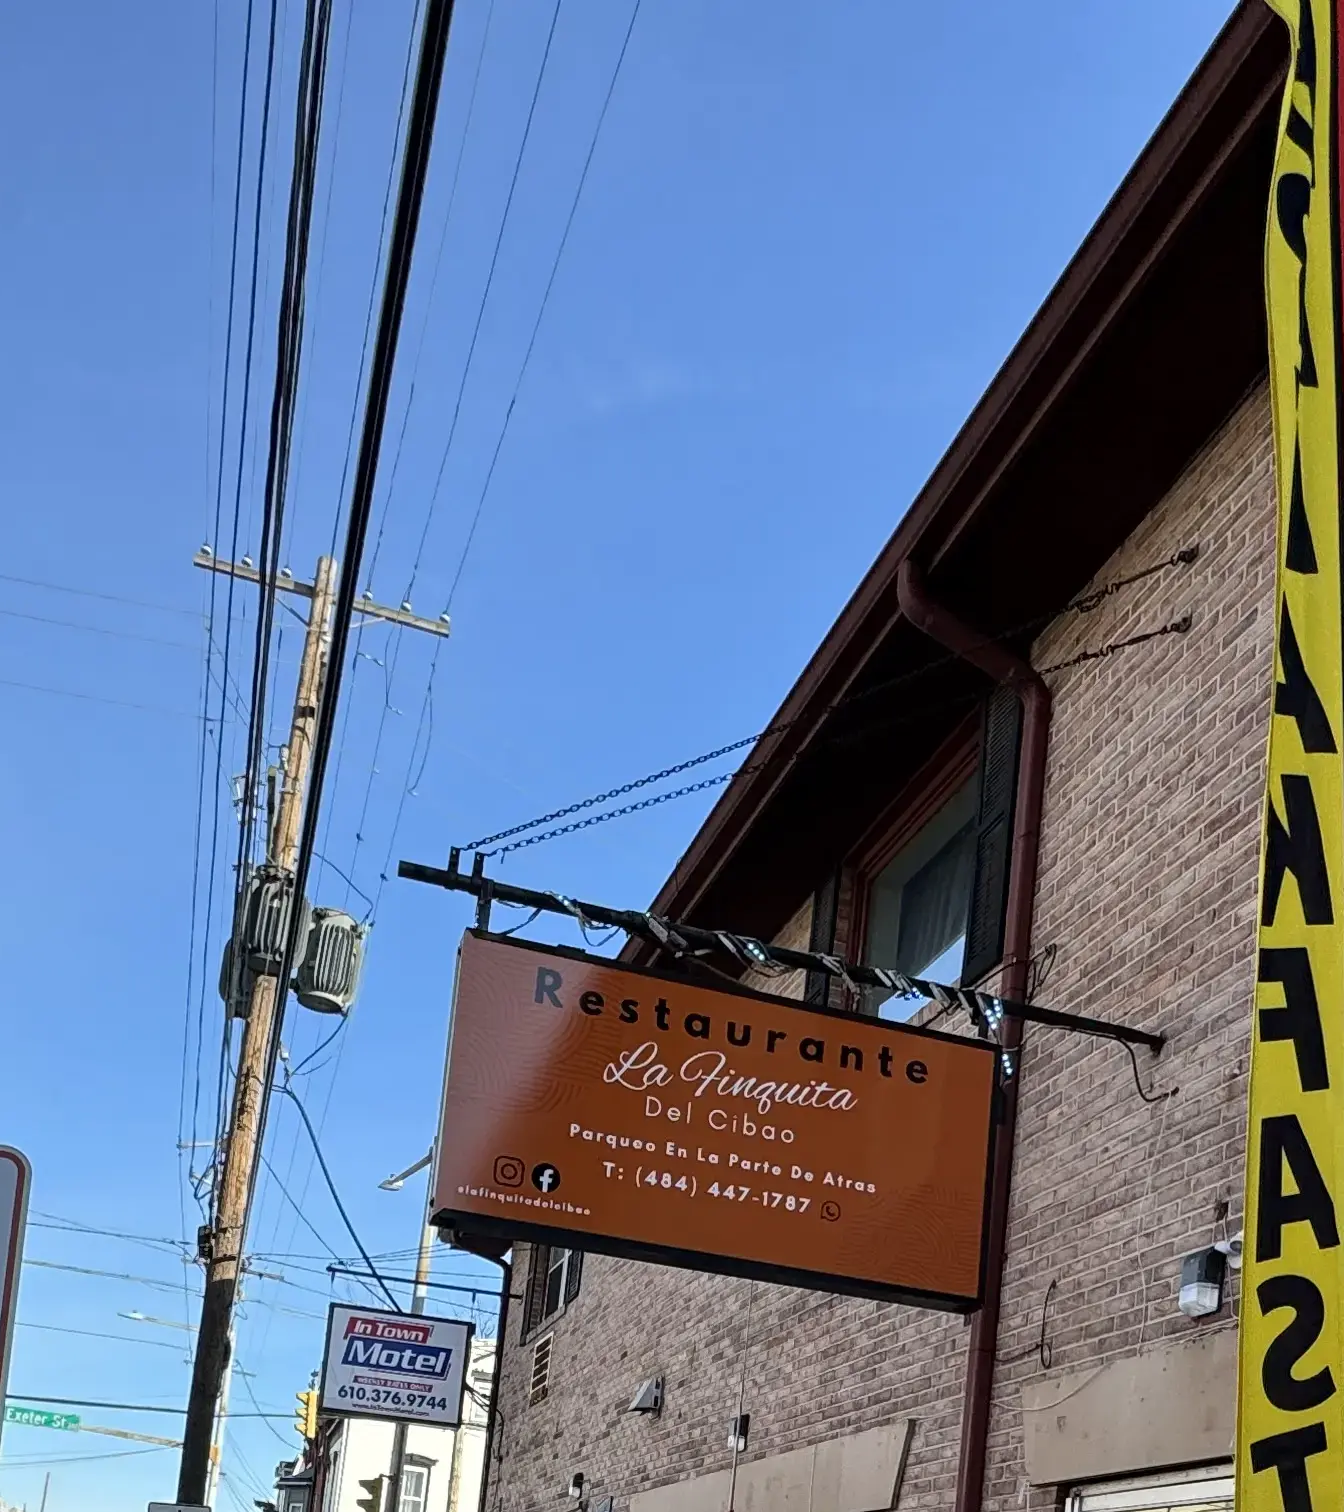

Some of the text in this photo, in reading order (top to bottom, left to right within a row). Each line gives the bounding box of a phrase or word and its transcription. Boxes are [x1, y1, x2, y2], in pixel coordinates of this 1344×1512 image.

[534, 965, 932, 1085] Restaurante
[603, 1041, 859, 1114] La Finquita
[645, 1096, 795, 1144] Del Cibao
[569, 1123, 877, 1194] Parqueo En La Parte De Atras
[602, 1161, 811, 1213] T: (484) 447-1787
[353, 1319, 425, 1342] In Town
[347, 1339, 447, 1375] Motel
[6, 1407, 48, 1426] Exeter
[337, 1384, 448, 1411] 610.376.9744
